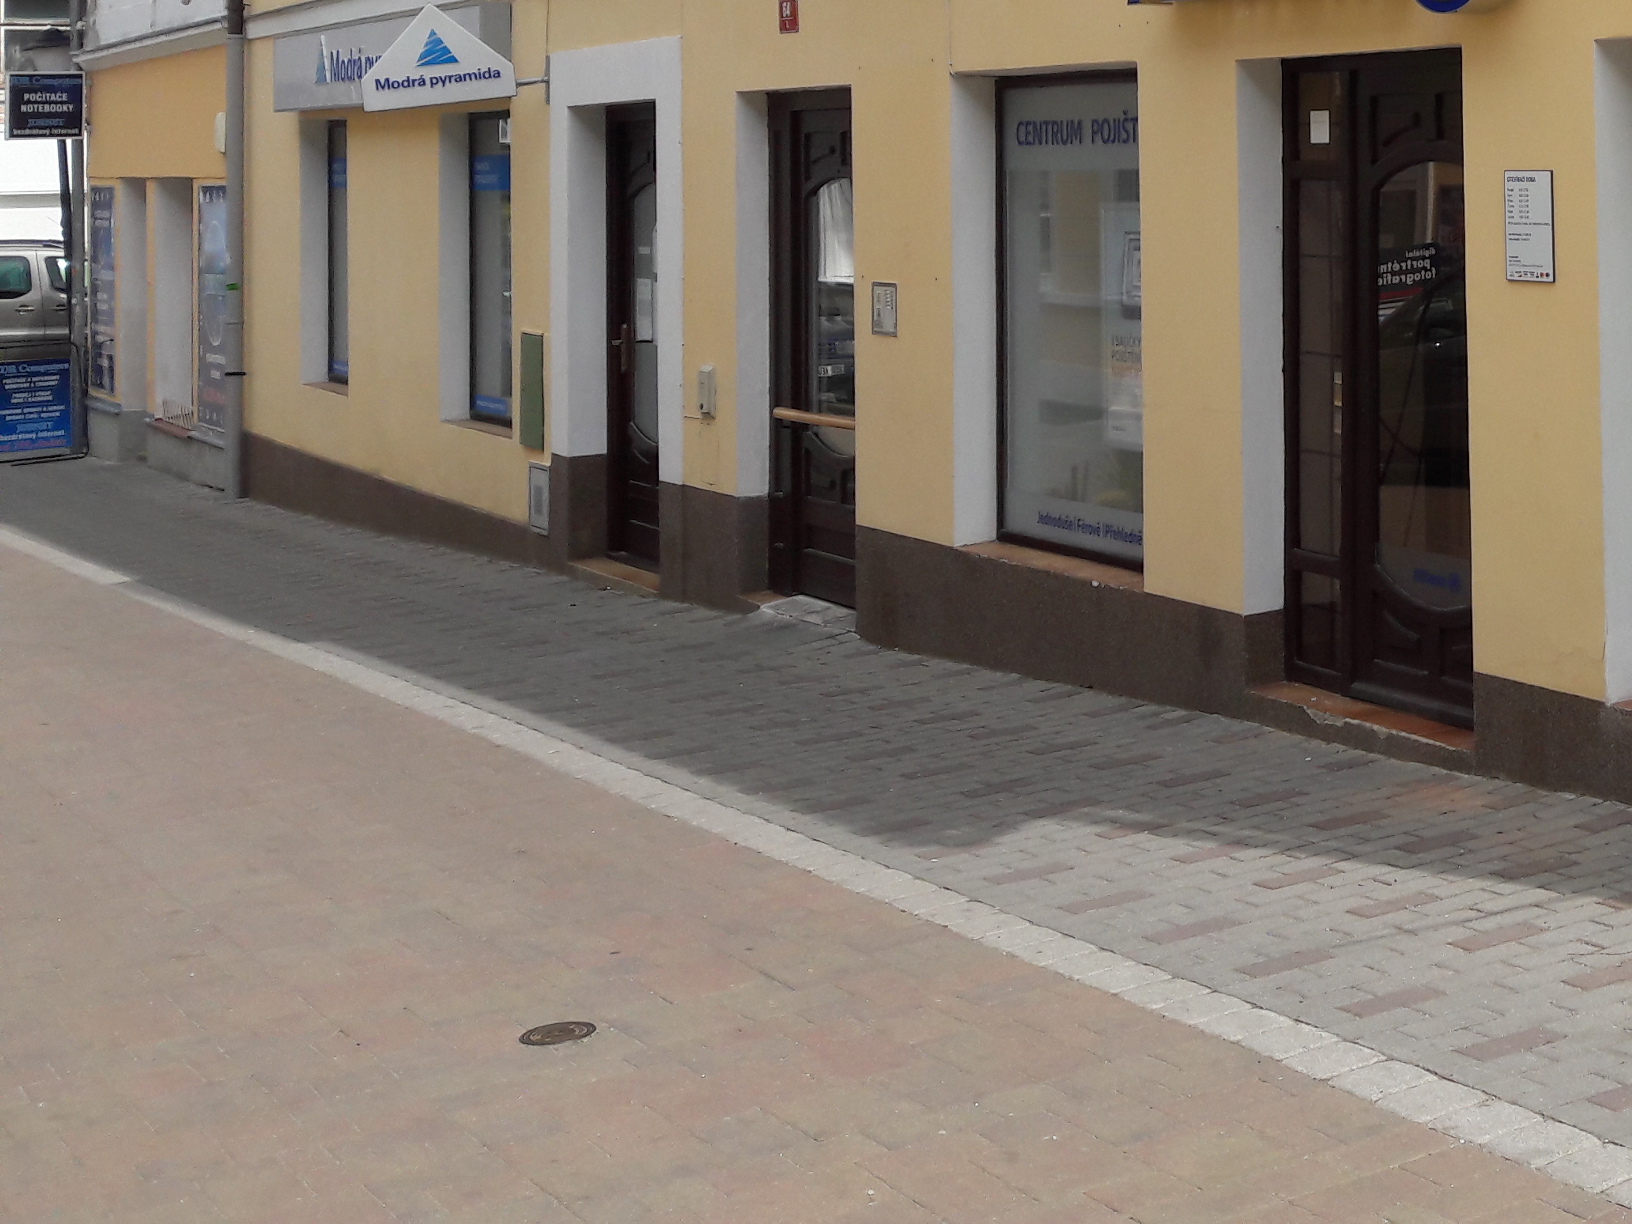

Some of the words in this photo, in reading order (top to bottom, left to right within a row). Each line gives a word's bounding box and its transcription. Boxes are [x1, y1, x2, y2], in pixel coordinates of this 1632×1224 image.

[330, 47, 362, 82] Modrá
[375, 75, 426, 91] Modrá
[430, 67, 501, 89] pyramida
[20, 103, 74, 113] NOTEBOOKY
[1016, 119, 1082, 146] CENTRUM
